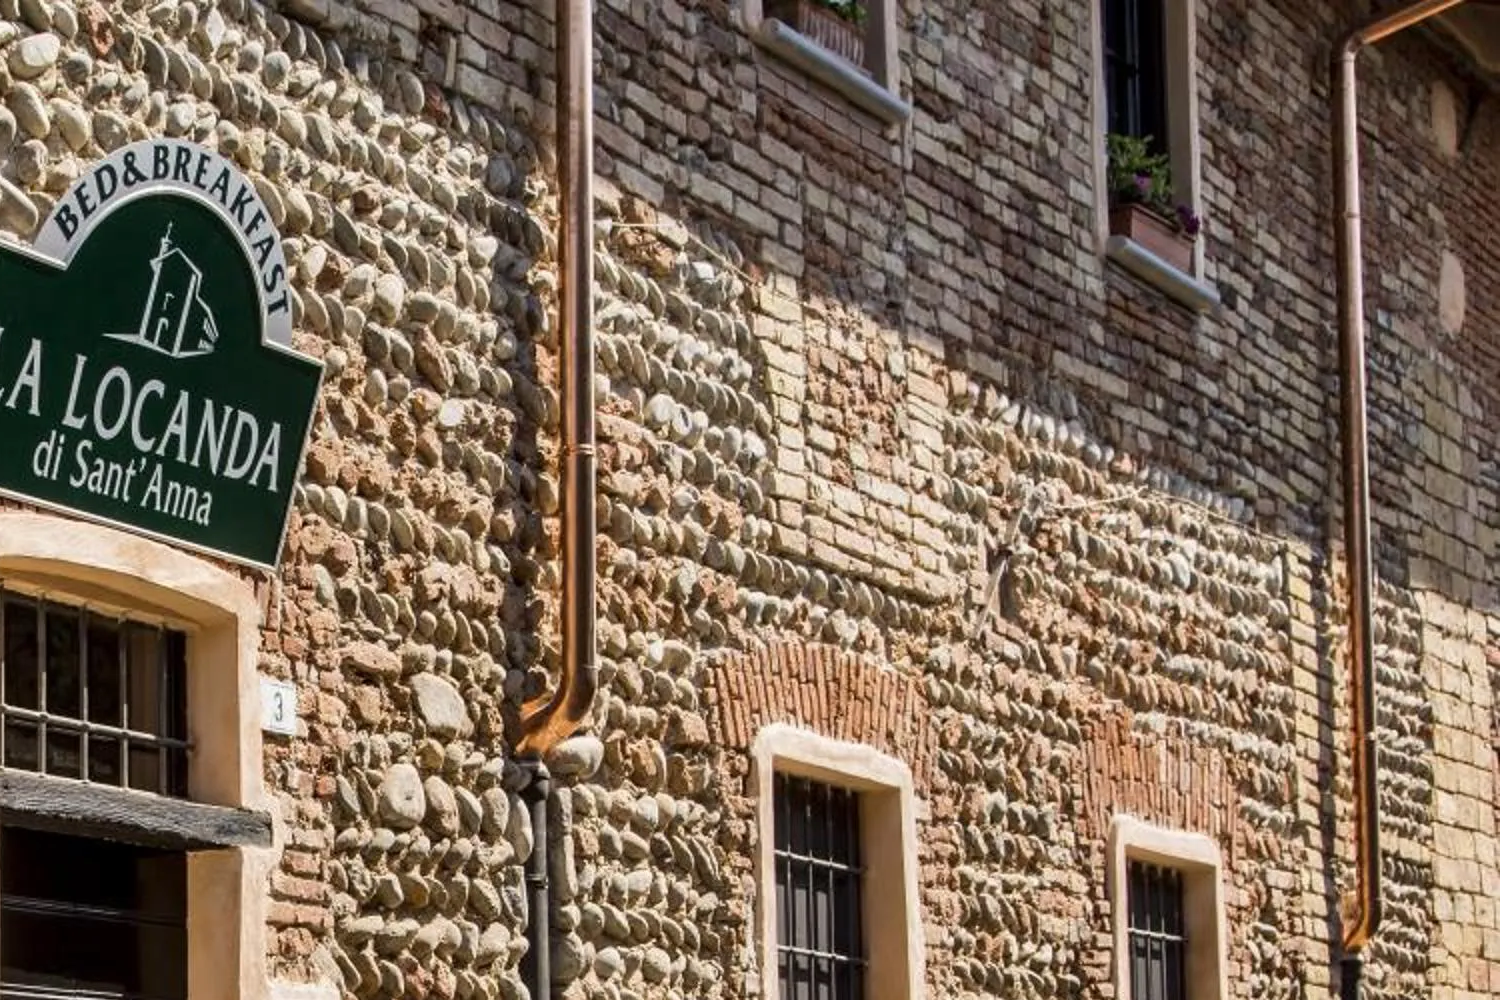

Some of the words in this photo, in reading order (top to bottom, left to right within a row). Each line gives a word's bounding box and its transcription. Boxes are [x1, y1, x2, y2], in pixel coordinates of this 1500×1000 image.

[62, 353, 282, 493] LOCANDA
[32, 429, 65, 482] di
[69, 438, 214, 527] Sant'Anna
[274, 692, 283, 722] 3
